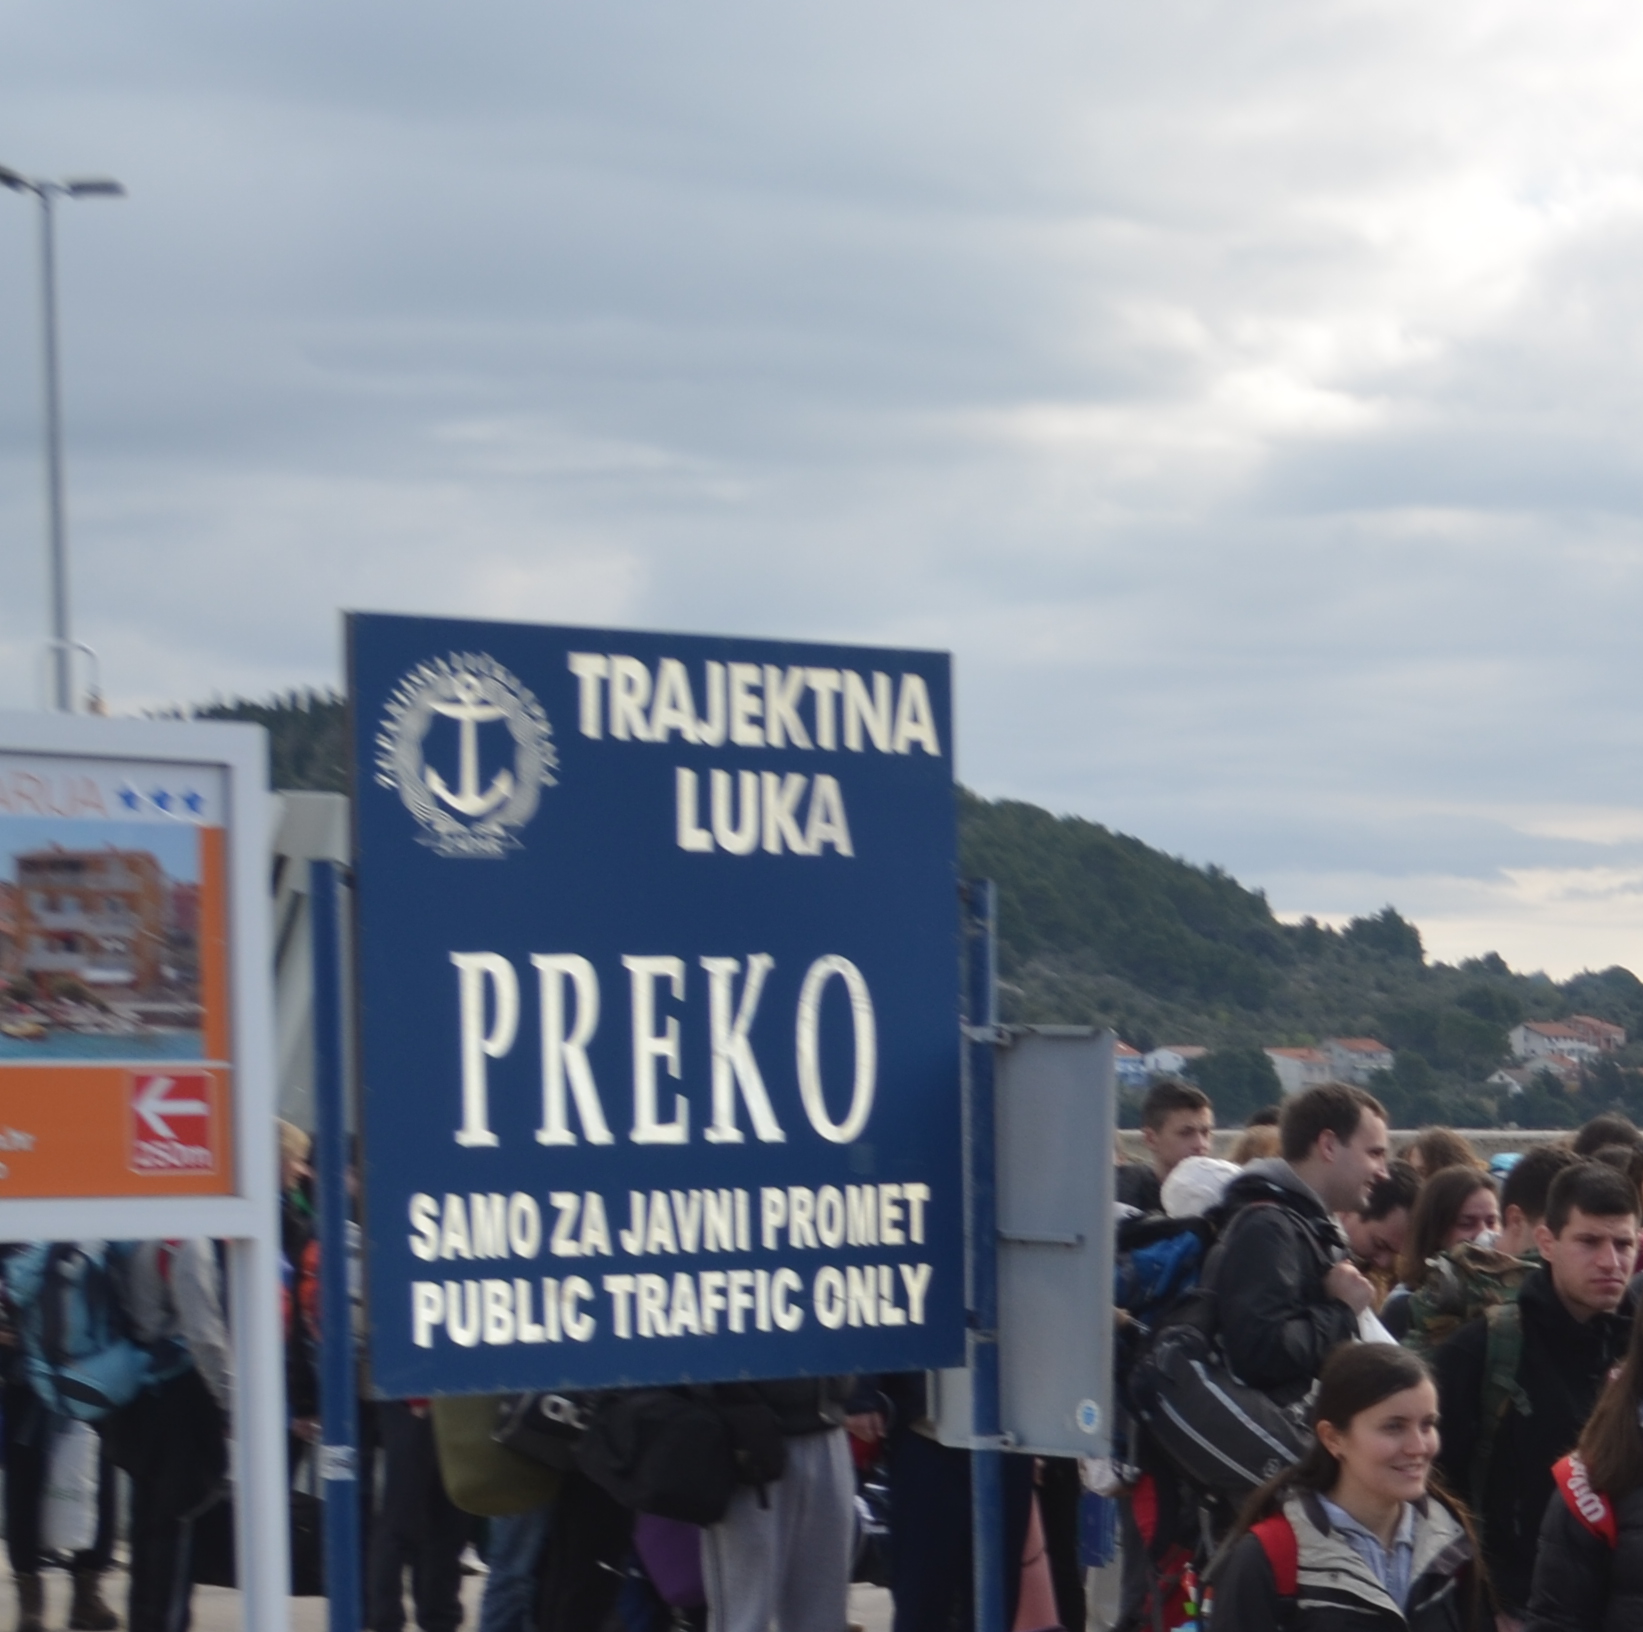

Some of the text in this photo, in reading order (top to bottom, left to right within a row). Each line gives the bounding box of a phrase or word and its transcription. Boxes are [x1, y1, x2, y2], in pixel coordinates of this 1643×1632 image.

[567, 651, 942, 757] TRAJEKTNA
[675, 766, 855, 858] LUKA
[448, 949, 878, 1149] PREKO
[408, 1181, 931, 1263] SAMO ZA JAVNI PROMET
[411, 1262, 934, 1349] PUBLIC TRAFFIC ONLY
